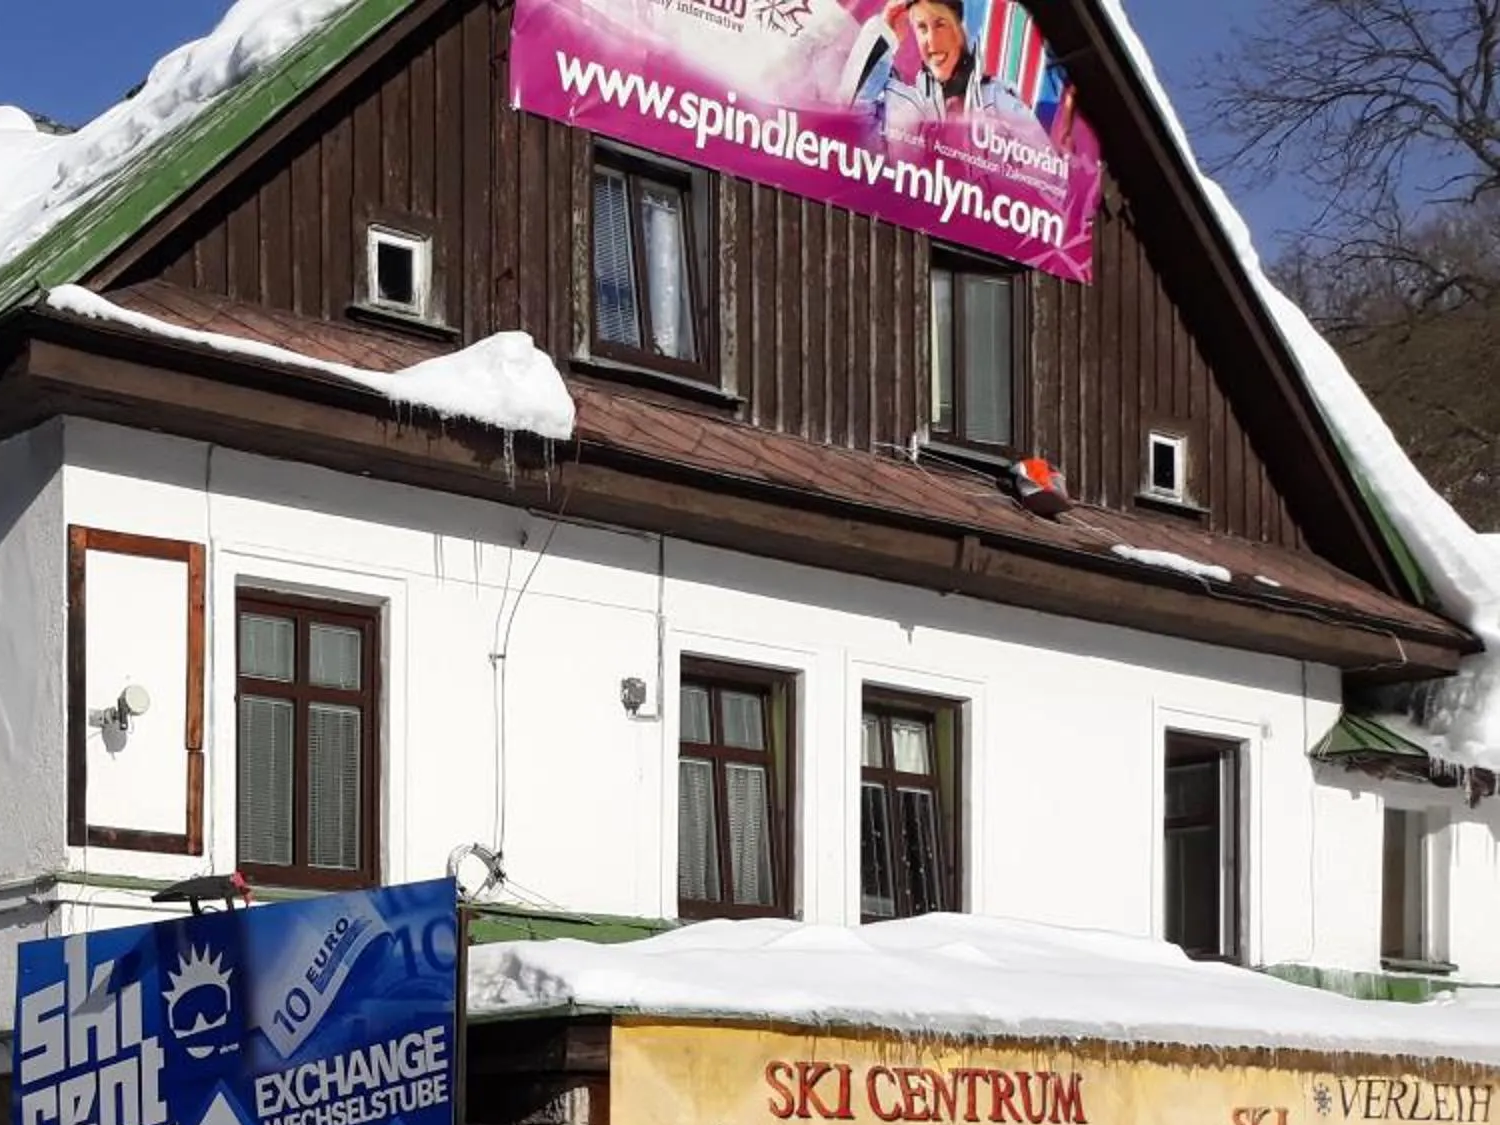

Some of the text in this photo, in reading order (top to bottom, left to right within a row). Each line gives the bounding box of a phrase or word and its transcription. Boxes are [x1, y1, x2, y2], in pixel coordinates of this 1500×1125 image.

[556, 50, 1065, 247] www.spindleruv-mlyn.com
[305, 916, 350, 985] EURO
[20, 932, 144, 1086] ski
[273, 986, 312, 1036] 10
[255, 1025, 449, 1118] EXCHANGE
[764, 1060, 1089, 1125] SKI CENTRUM
[1338, 1078, 1494, 1123] VERLEIH
